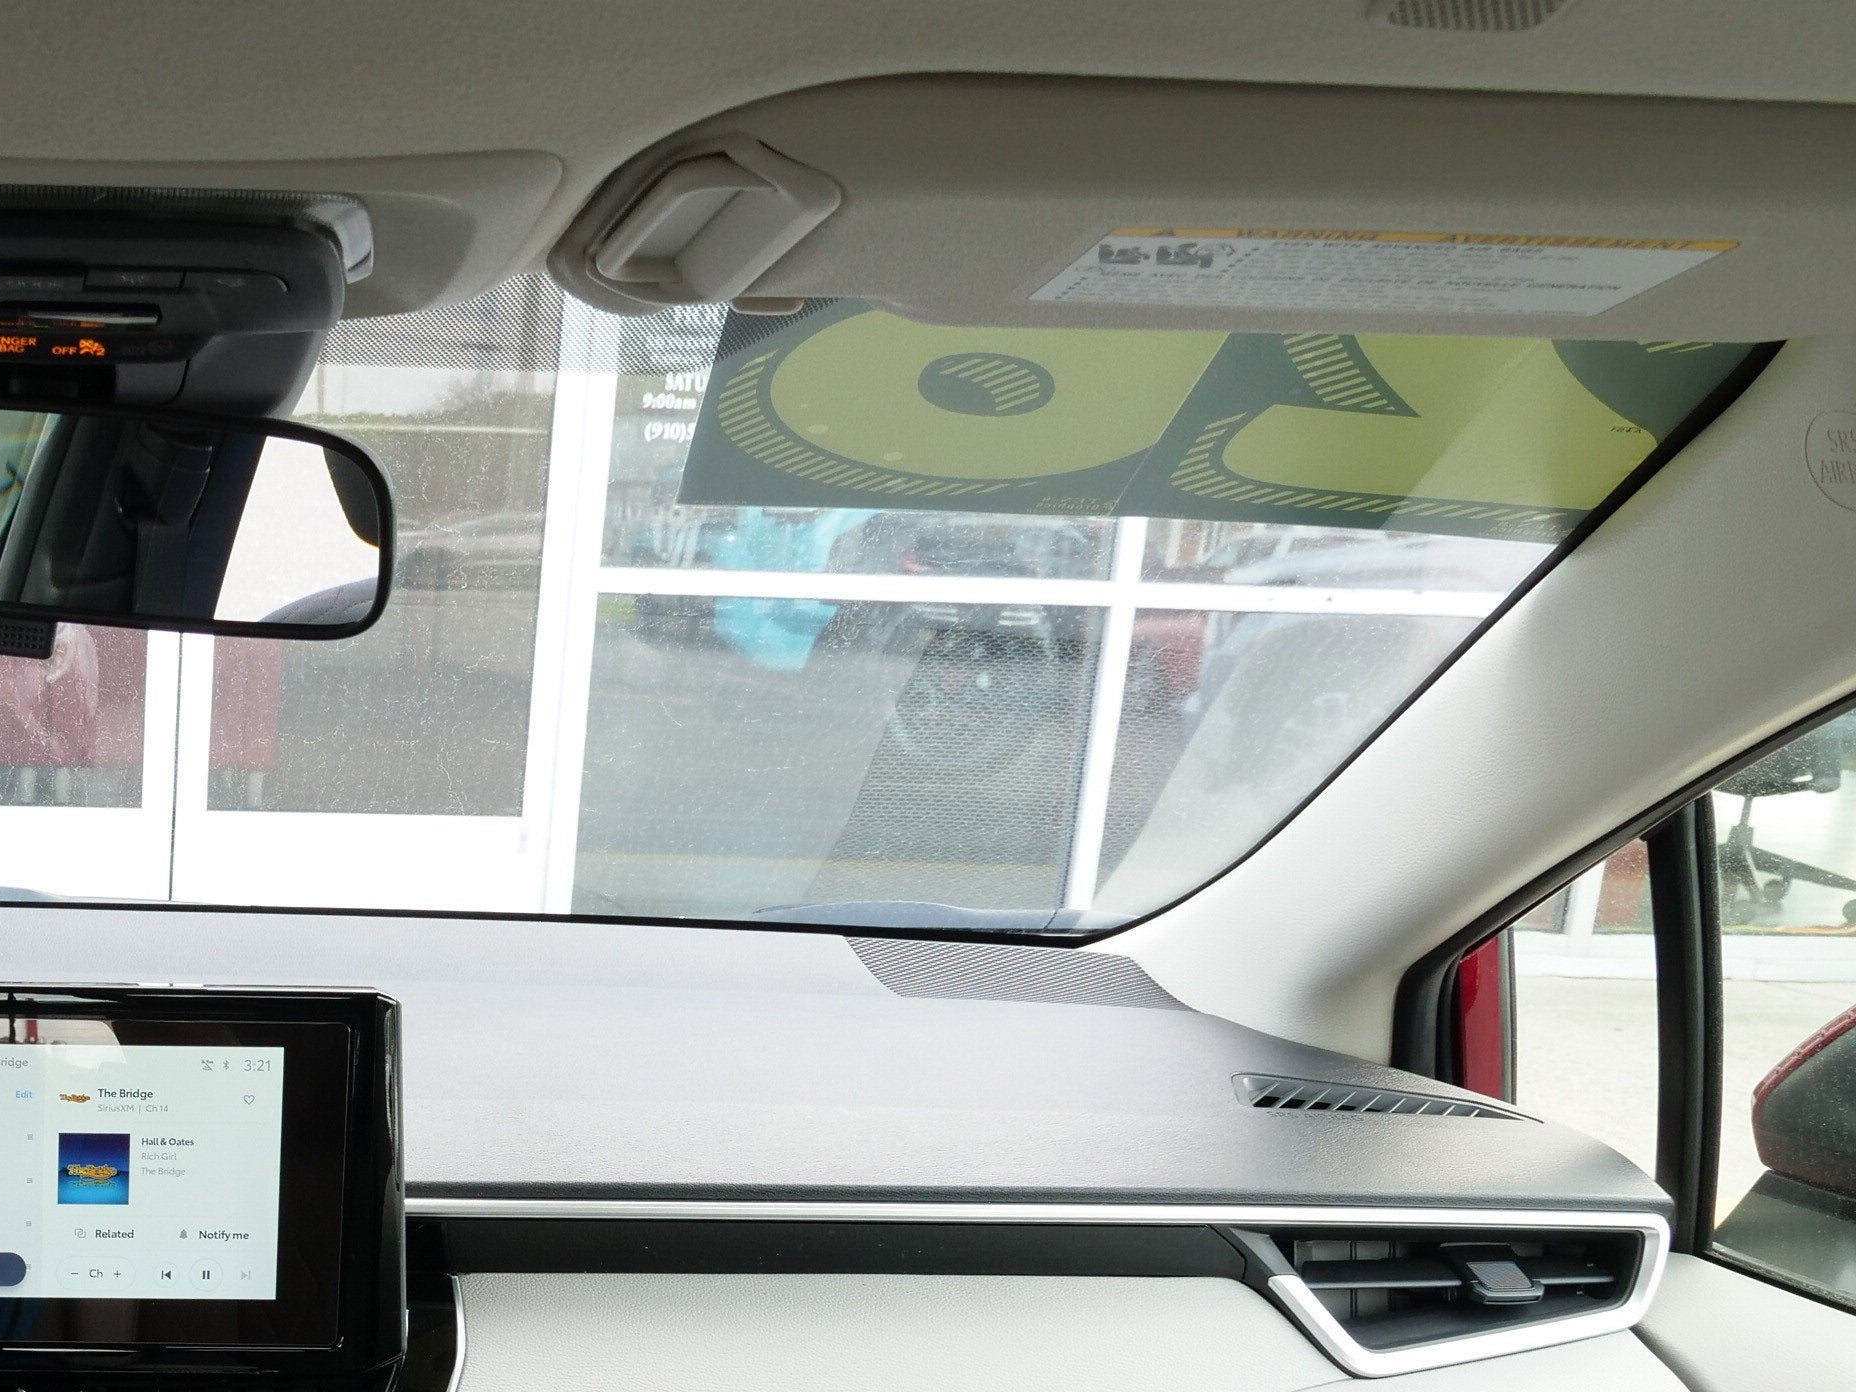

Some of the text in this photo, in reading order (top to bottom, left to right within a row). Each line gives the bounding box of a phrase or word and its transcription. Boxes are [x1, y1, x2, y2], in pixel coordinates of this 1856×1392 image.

[52, 346, 77, 355] OFF
[665, 371, 708, 392] SATU
[642, 392, 697, 410] 9:00am
[243, 1059, 271, 1072] 3:21
[15, 1090, 32, 1099] Edit
[98, 1088, 154, 1101] The Bridge
[98, 1104, 168, 1112] SiriusXM Ch 14
[141, 1137, 195, 1146] Hall & Oates
[141, 1152, 177, 1161] Rich Girl
[141, 1167, 186, 1177] The Bridge
[95, 1229, 135, 1239] Related
[198, 1230, 249, 1242] Notify me
[89, 1268, 103, 1278] Ch
